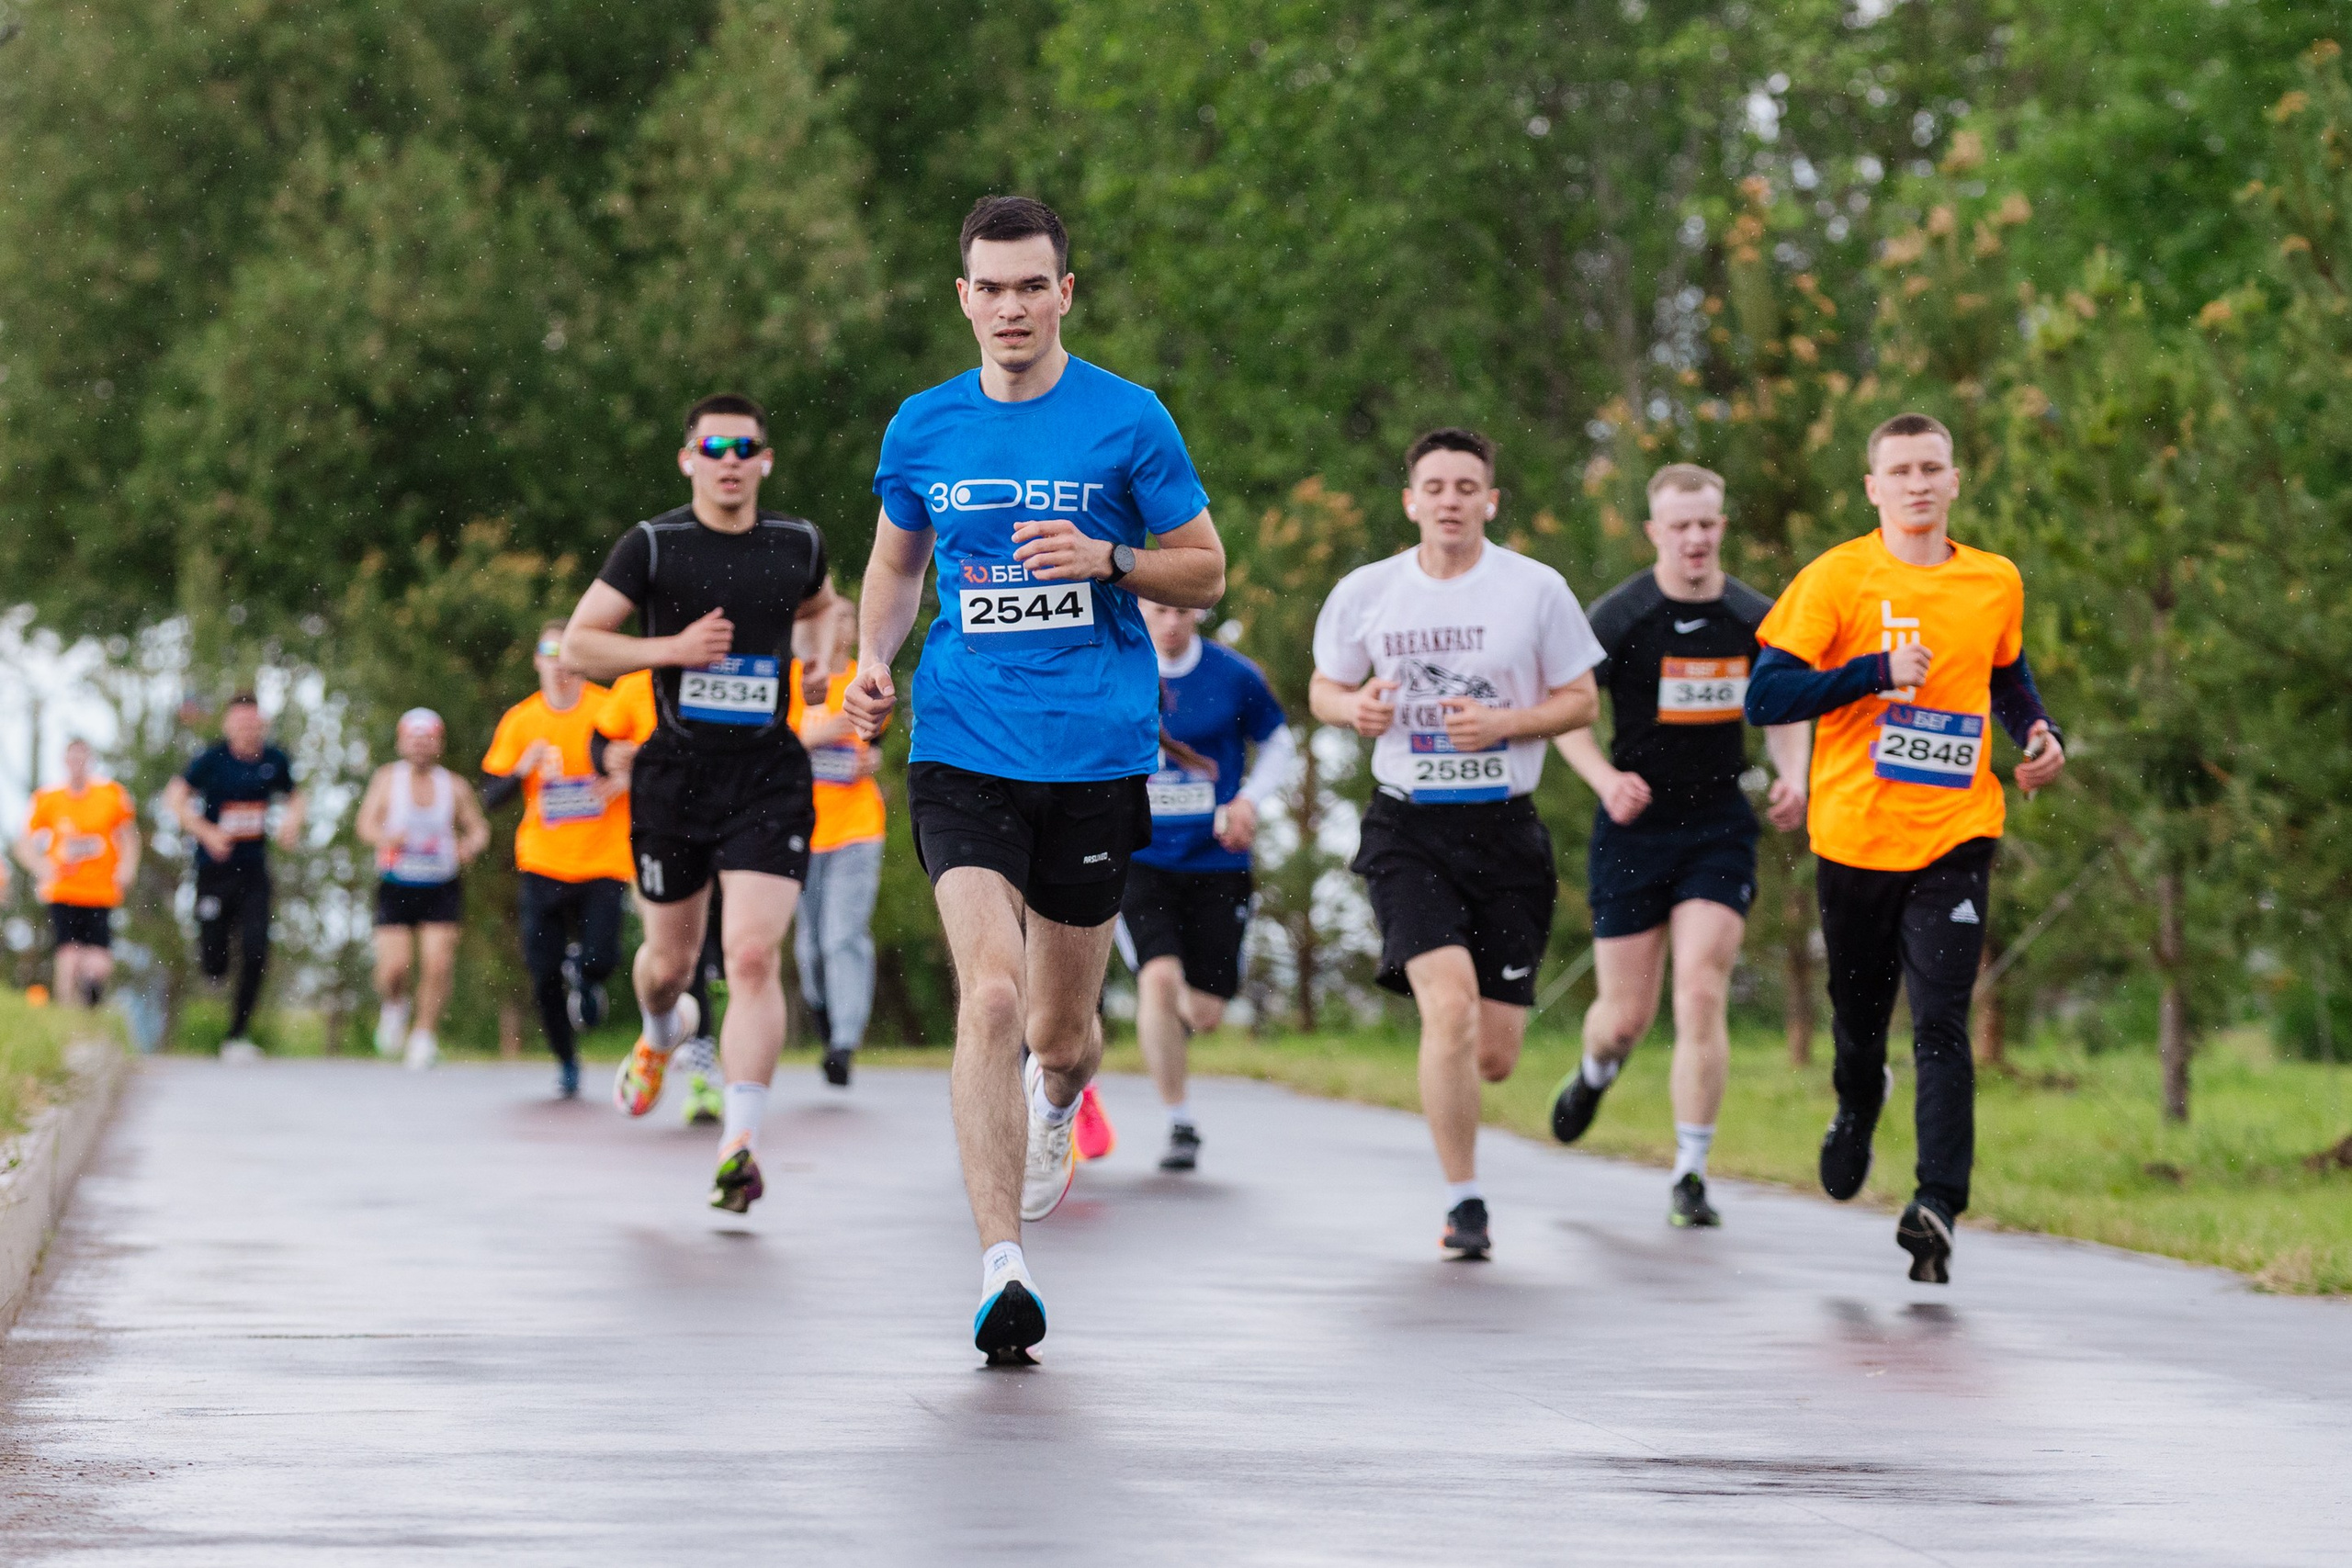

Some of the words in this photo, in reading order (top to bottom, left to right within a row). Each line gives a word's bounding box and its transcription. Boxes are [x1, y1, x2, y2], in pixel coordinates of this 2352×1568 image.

[968, 591, 1083, 625] 2544
[1383, 626, 1485, 657] BREAKFAST
[689, 678, 767, 703] 2534
[1884, 734, 1973, 766] 2848
[1417, 757, 1503, 781] 2586
